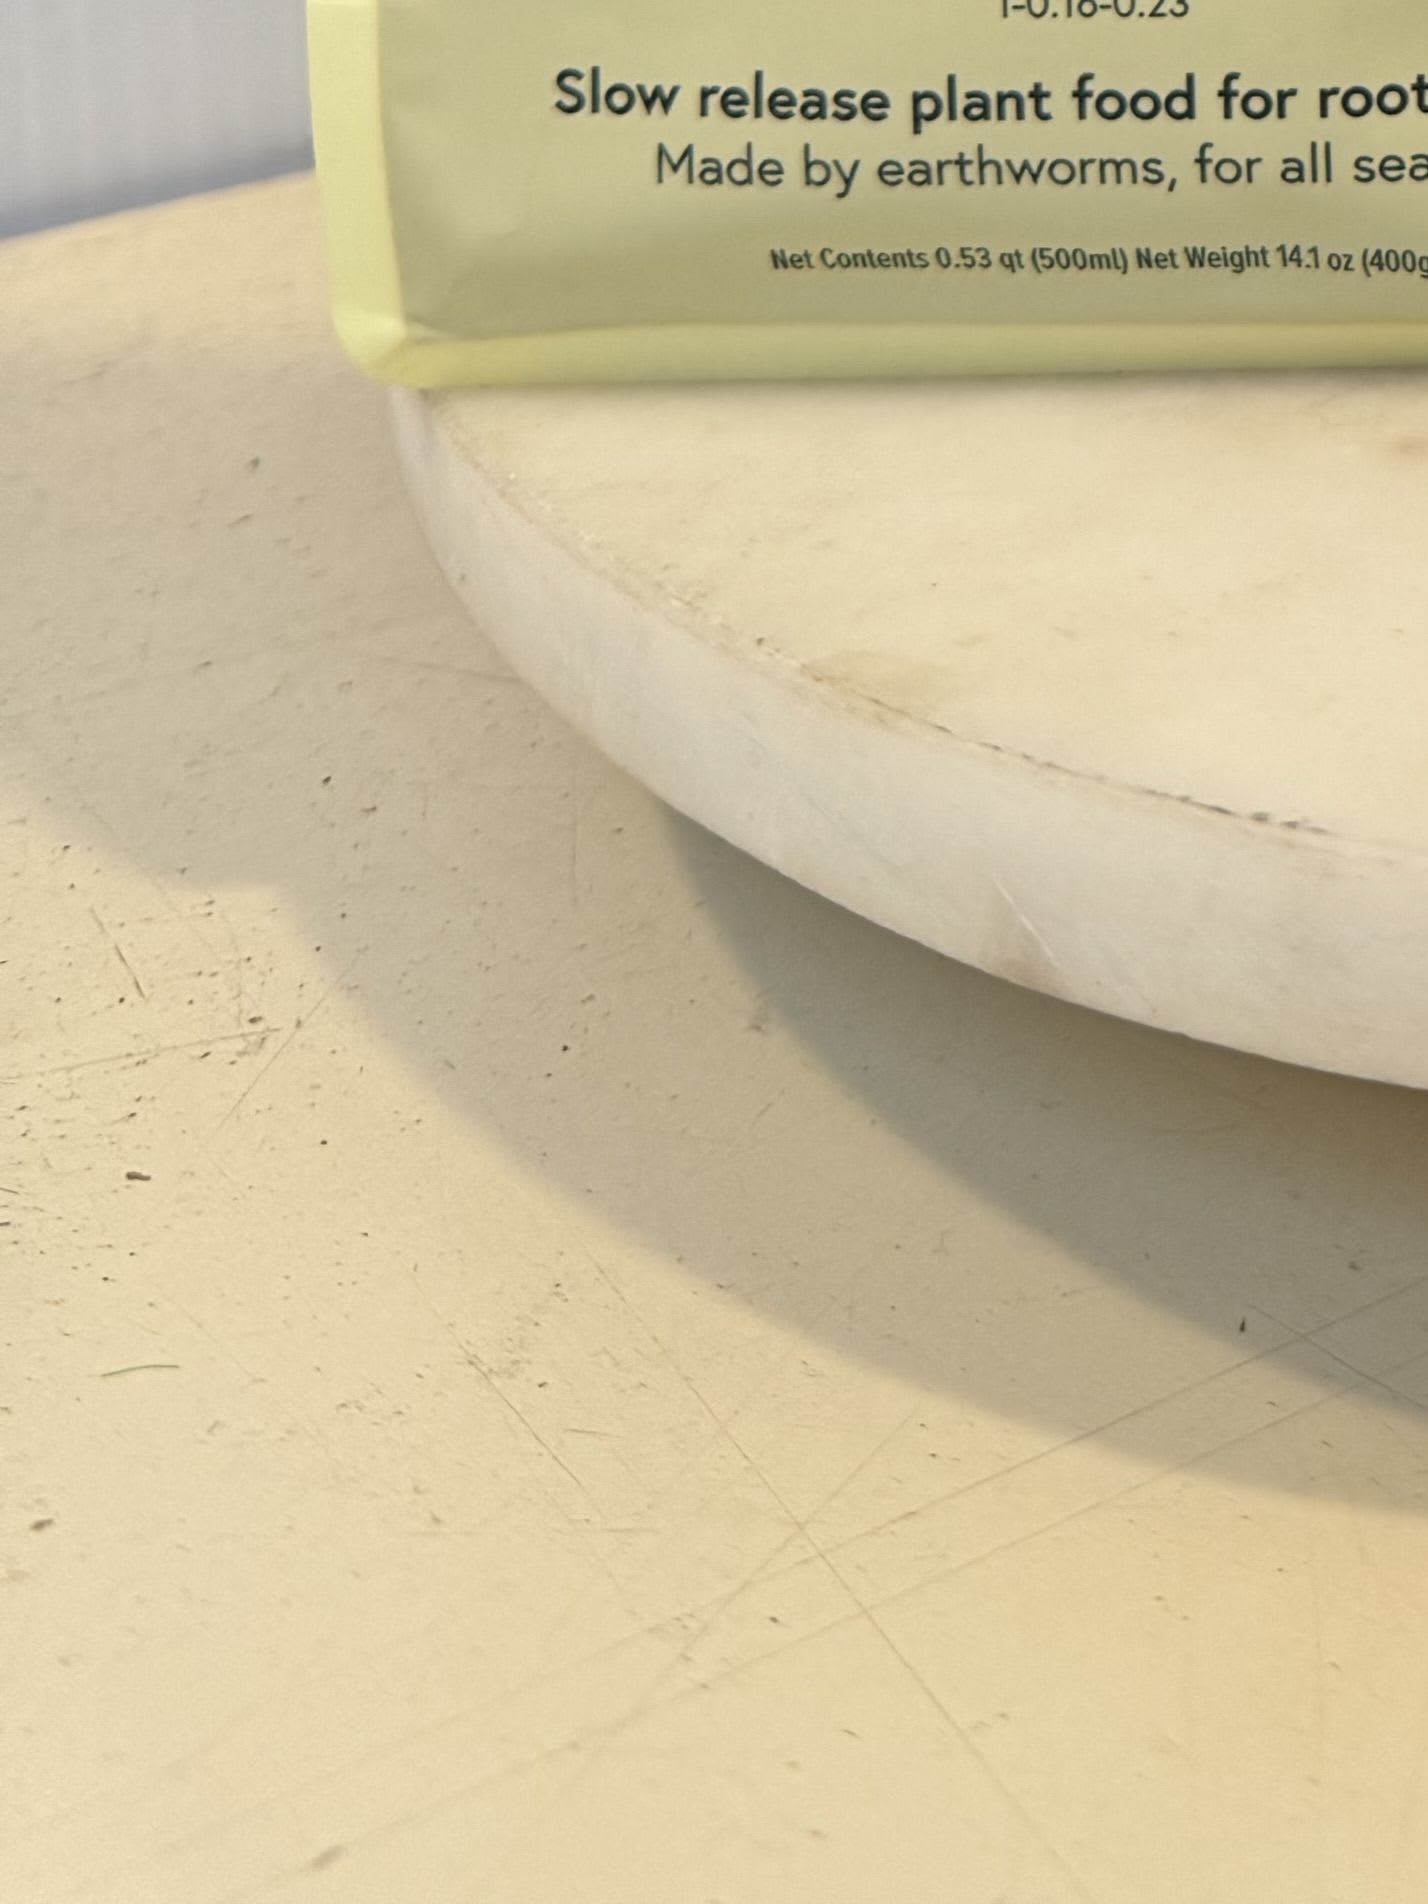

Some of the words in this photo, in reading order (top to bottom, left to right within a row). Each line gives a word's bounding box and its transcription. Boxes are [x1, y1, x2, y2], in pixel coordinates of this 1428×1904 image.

[555, 66, 680, 115] Slow
[700, 70, 890, 121] release
[912, 74, 1052, 134] plant
[1072, 73, 1196, 120] food
[1217, 72, 1297, 120] for
[657, 142, 785, 186] Made
[803, 143, 861, 199] by
[877, 143, 1177, 192] earthworms,
[1195, 142, 1262, 184] for
[1280, 141, 1333, 184] all
[770, 248, 815, 270] Net
[821, 248, 929, 271] Contents
[935, 247, 992, 269] 0.53
[1000, 249, 1024, 273] qt
[1031, 248, 1129, 274] (500ml)
[1137, 247, 1178, 270] Net
[1184, 245, 1269, 274] Weight
[1276, 245, 1319, 269] 14.1
[1327, 251, 1354, 271] oz
